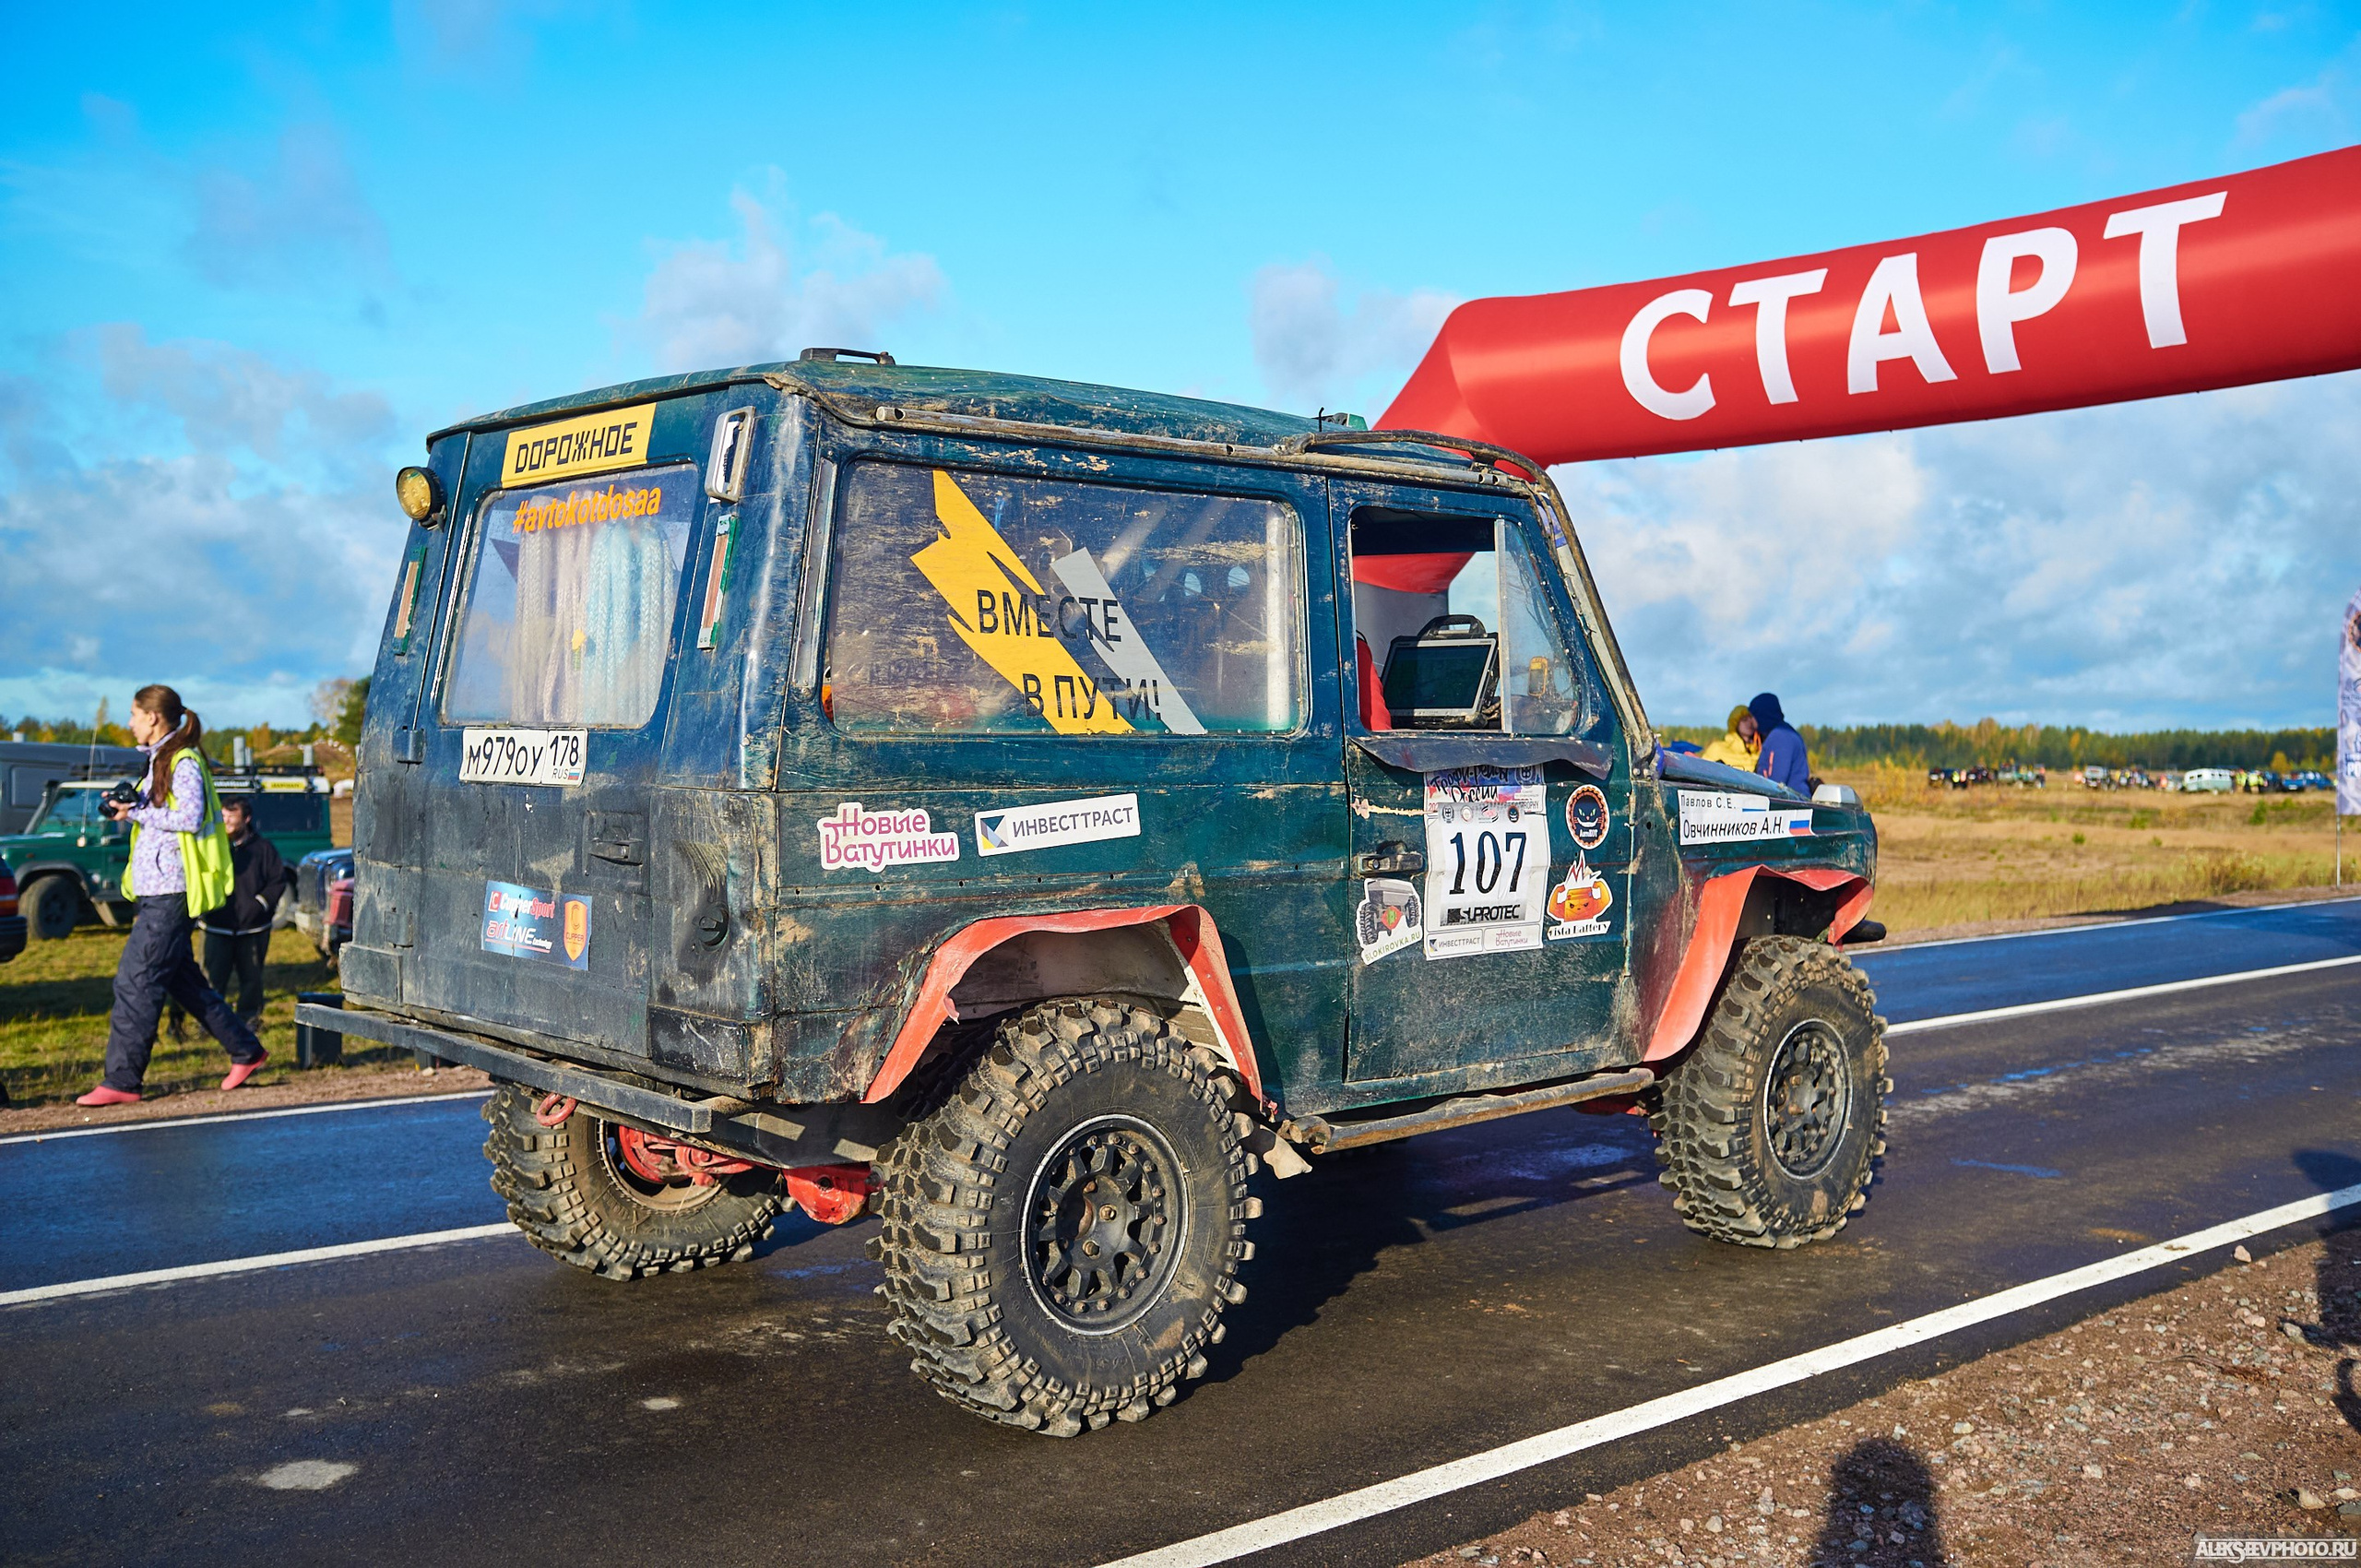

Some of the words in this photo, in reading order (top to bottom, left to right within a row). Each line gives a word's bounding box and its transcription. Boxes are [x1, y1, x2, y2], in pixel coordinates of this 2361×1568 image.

[1619, 191, 2228, 421] СТАРТ
[512, 484, 661, 534] #avtokotdosaa
[977, 589, 1122, 643] ВМЕСТЕ
[1023, 673, 1045, 718] В
[1054, 675, 1162, 721] ПУТИ!
[467, 736, 544, 777] М979ОУ
[550, 735, 579, 766] 178
[552, 768, 568, 779] RUS
[1681, 795, 1712, 808] Павлов
[824, 808, 926, 837] Новые
[1014, 807, 1134, 837] ИНВЕСТТРАСТ
[1683, 819, 1757, 838] Овчинников
[825, 829, 955, 867] Ватутинки
[1449, 830, 1527, 895] 107
[1460, 904, 1521, 922] SUPROTEC
[1365, 931, 1421, 962] BLOKIROVKA.RU
[1439, 937, 1480, 948] ИНВЕСТТРАСТ
[1496, 929, 1522, 939] Новые
